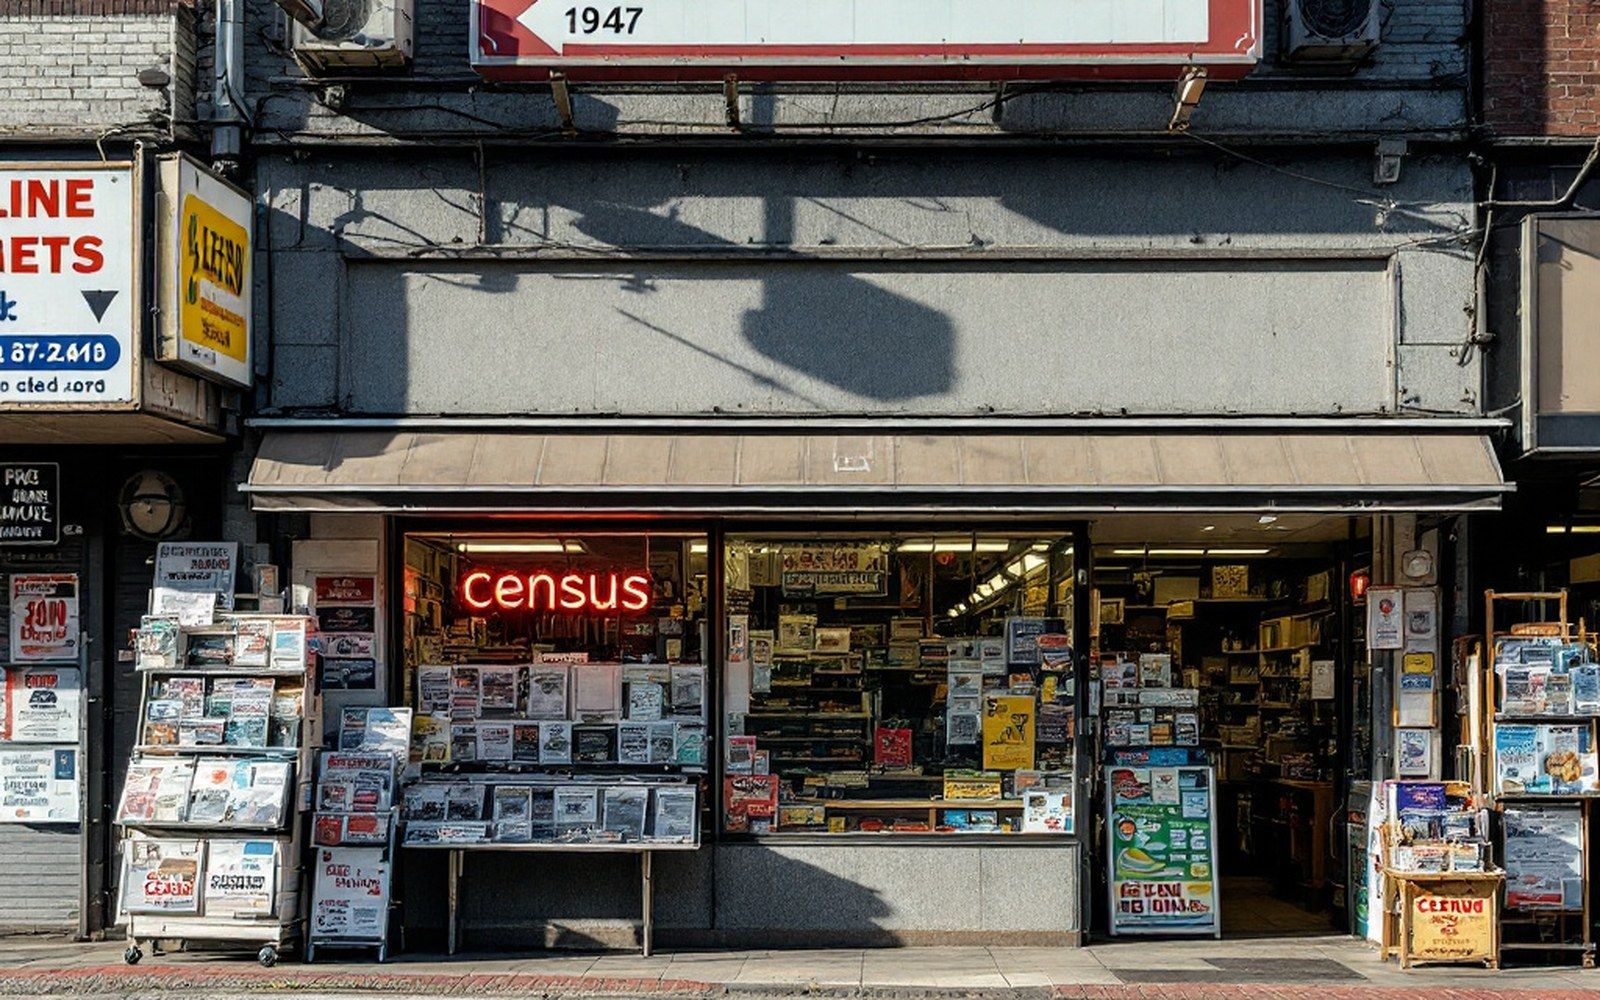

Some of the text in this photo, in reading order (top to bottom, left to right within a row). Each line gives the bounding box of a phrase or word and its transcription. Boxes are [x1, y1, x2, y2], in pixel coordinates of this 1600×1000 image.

[564, 7, 643, 34] 1947
[0, 235, 104, 274] ETS
[463, 572, 650, 610] census
